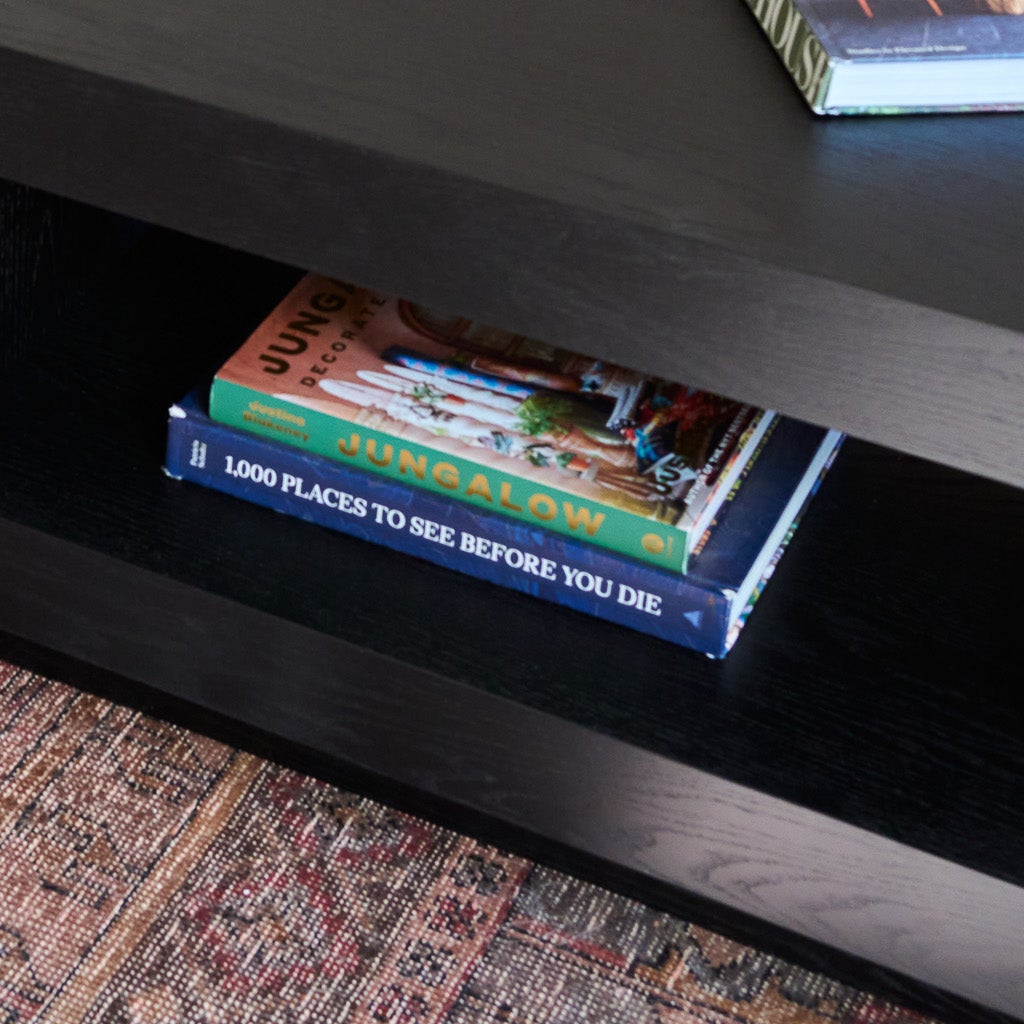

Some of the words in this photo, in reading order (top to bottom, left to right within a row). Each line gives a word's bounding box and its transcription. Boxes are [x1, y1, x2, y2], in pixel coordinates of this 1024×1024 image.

[300, 296, 386, 388] DECORATE
[242, 410, 310, 443] Blakeney
[337, 432, 606, 536] JUNGALOW
[224, 455, 277, 488] 1,000
[281, 472, 368, 518] PLACES
[371, 502, 406, 530] TO
[409, 516, 456, 548] SEE
[460, 531, 557, 581] BEFORE
[561, 564, 614, 598] YOU
[616, 583, 663, 617] DIE
